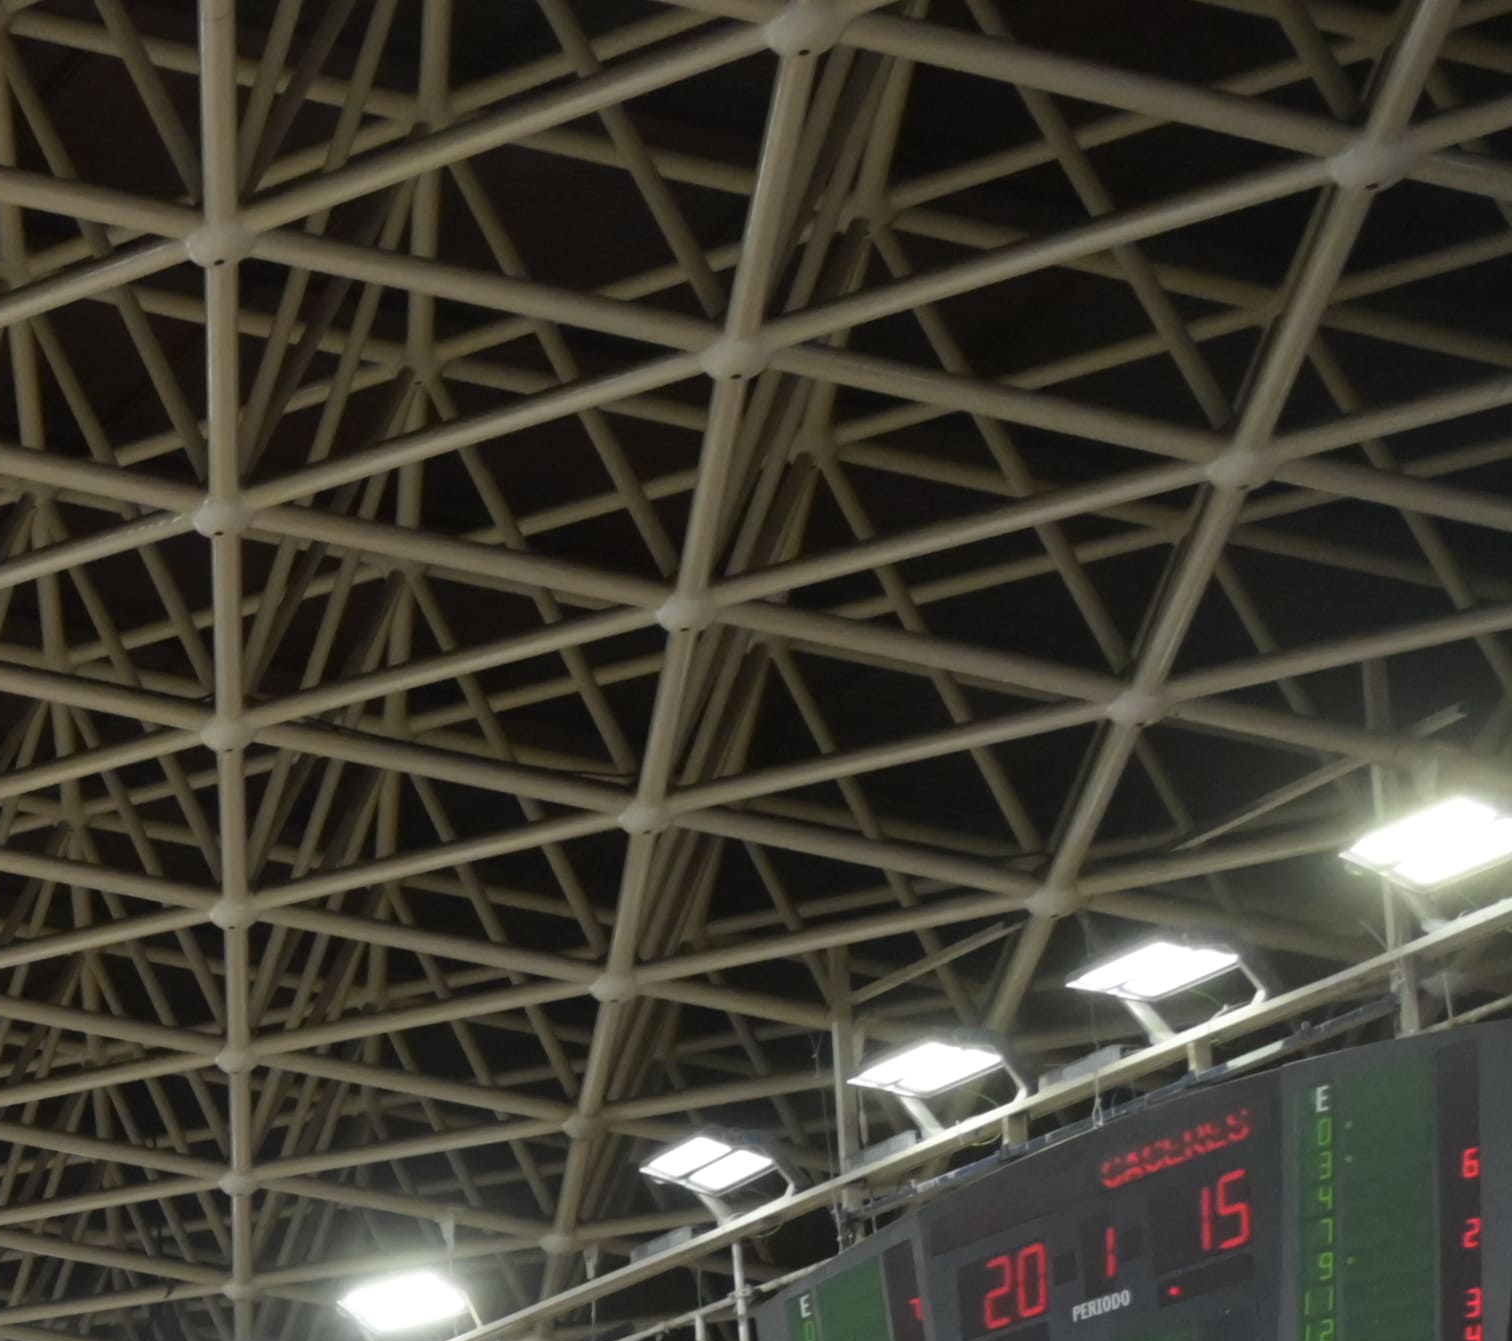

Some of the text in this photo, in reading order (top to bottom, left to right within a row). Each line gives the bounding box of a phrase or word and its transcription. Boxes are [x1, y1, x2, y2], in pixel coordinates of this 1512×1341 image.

[1461, 1147, 1481, 1179] 6
[982, 1242, 1050, 1331] 20
[1200, 1168, 1253, 1252] 15
[1461, 1216, 1483, 1249] 2
[1071, 1289, 1132, 1324] PERIODO
